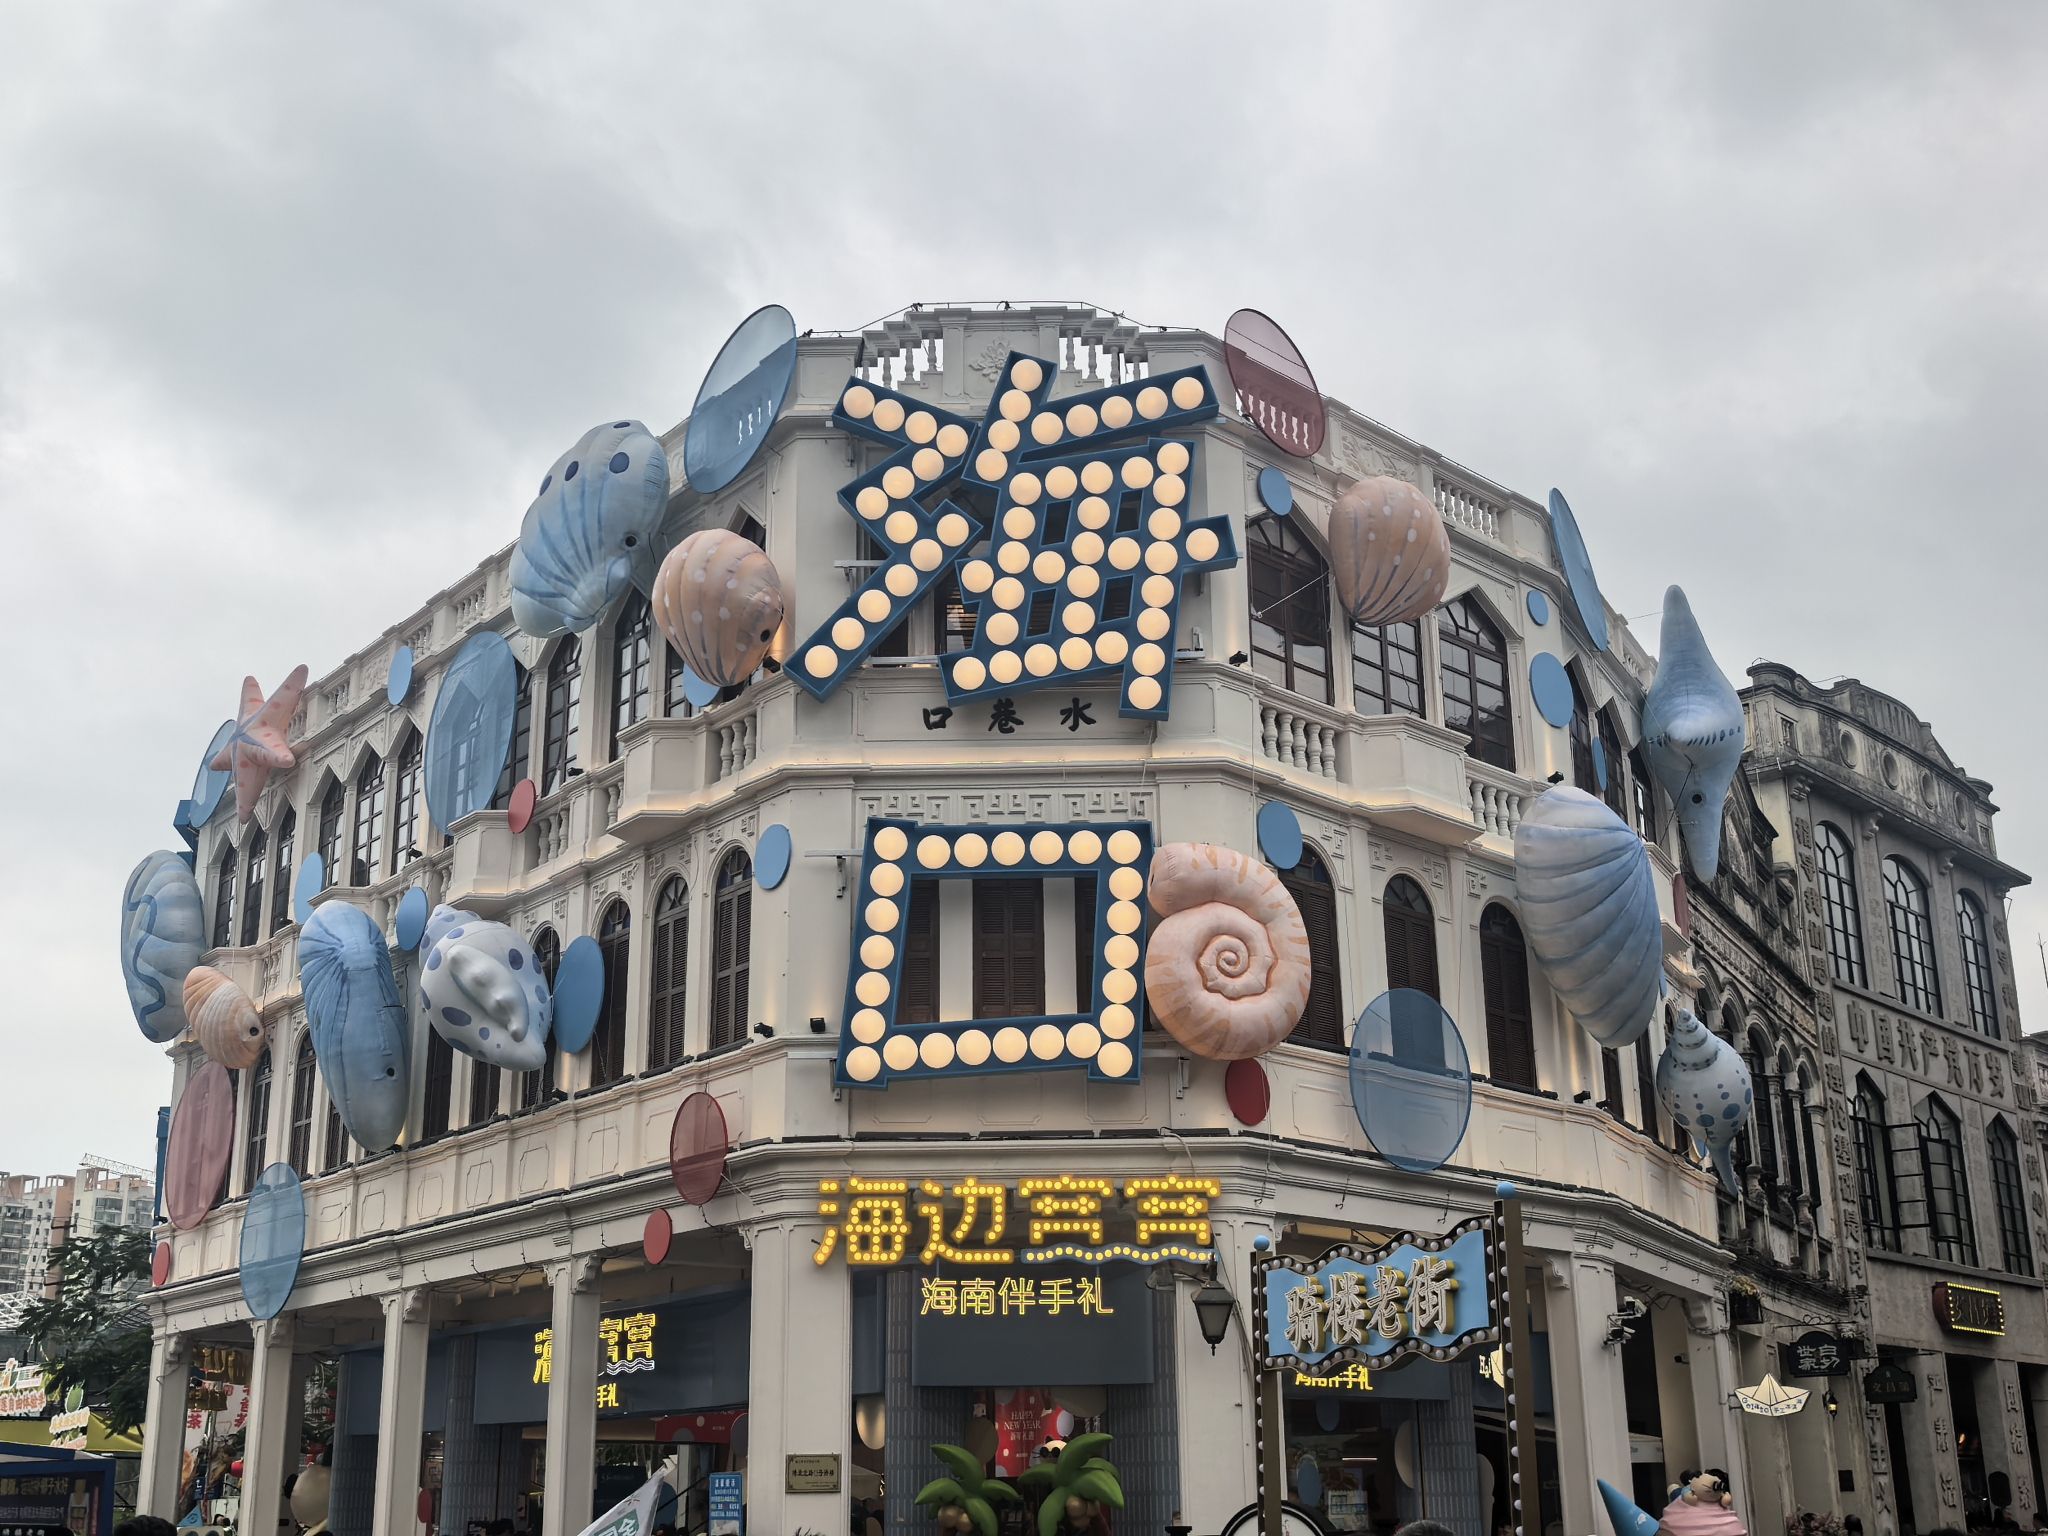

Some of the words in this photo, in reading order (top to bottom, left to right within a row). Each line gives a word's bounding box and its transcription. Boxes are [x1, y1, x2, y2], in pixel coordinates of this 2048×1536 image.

[783, 350, 1238, 722] 海
[1846, 1000, 2006, 1099] 中国共产党万岁
[920, 1277, 1114, 1316] 海南伴手礼
[1284, 1255, 1460, 1354] 骑楼老街
[1003, 1421, 1021, 1430] NEW
[1022, 1420, 1041, 1429] YEAR
[1011, 1410, 1034, 1420] HAPPY
